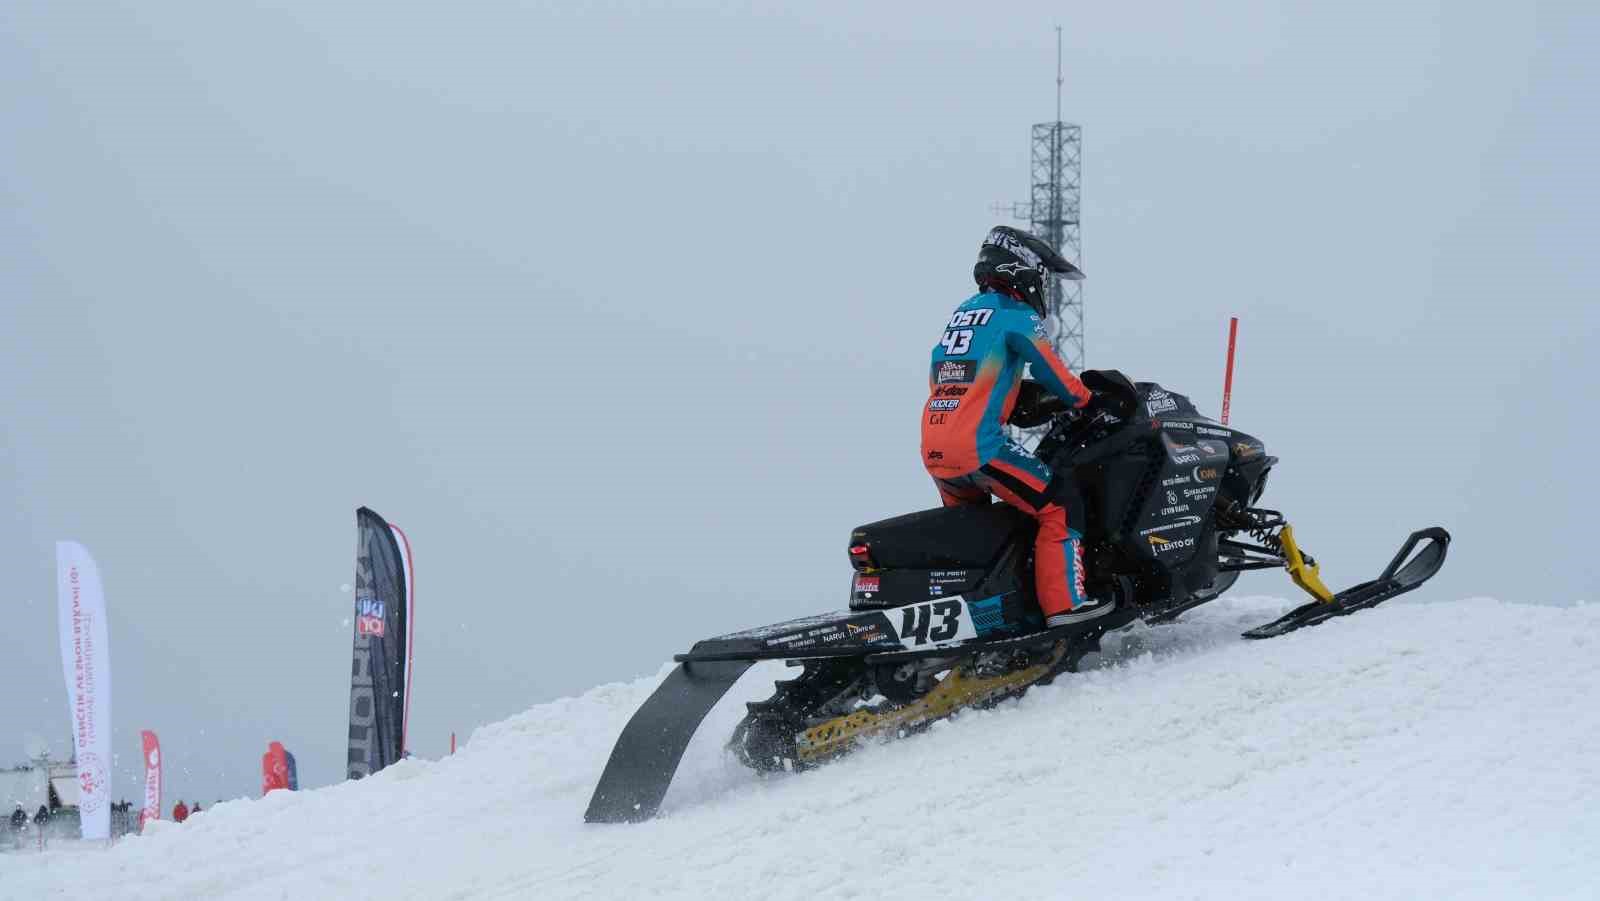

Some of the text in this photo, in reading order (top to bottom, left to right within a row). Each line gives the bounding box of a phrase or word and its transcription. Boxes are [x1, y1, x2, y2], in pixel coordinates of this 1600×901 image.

[941, 329, 974, 355] 43
[1160, 540, 1184, 552] LEHTO
[900, 599, 963, 646] 43
[823, 632, 845, 643] NARVI
